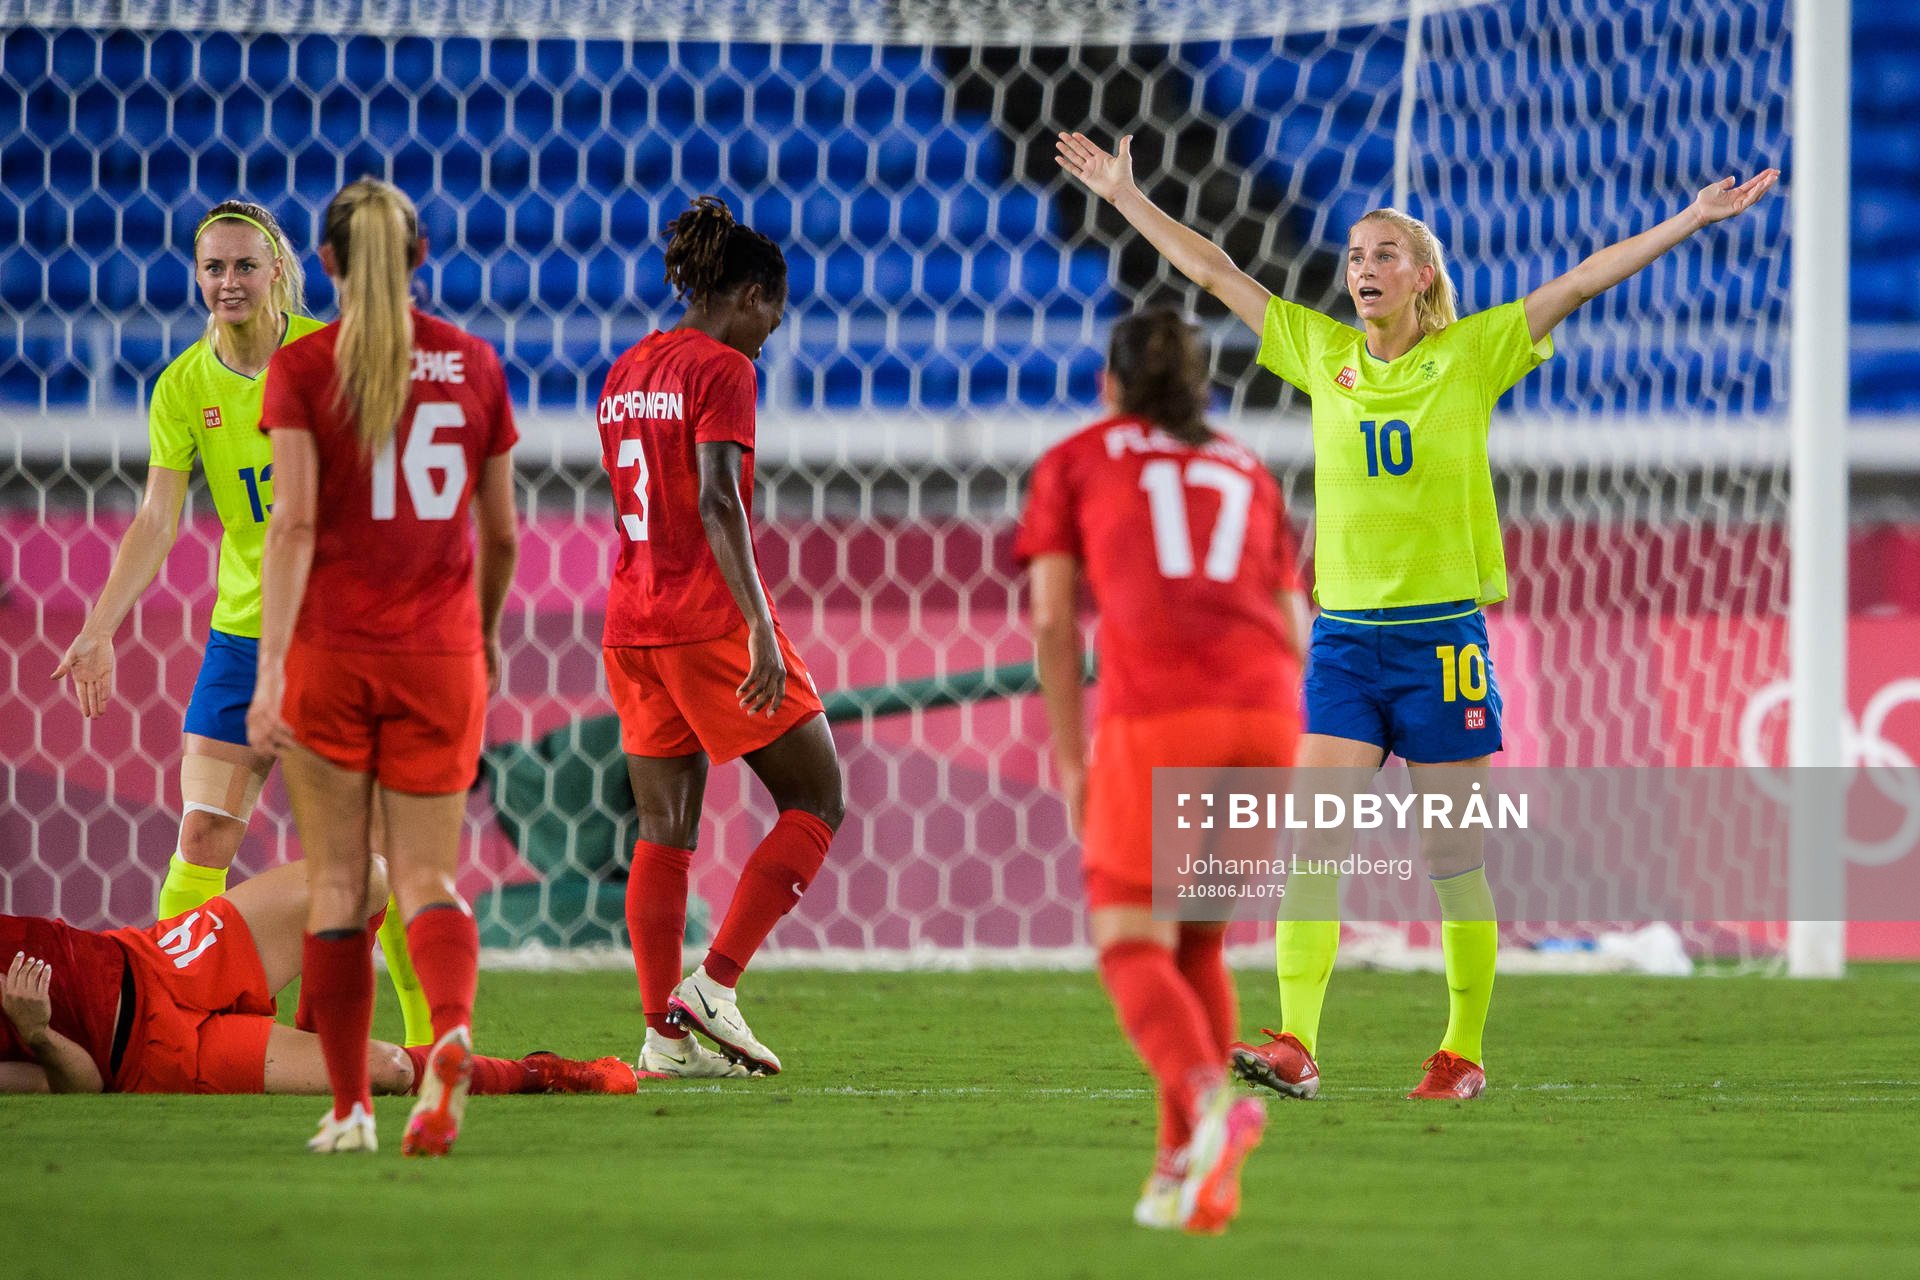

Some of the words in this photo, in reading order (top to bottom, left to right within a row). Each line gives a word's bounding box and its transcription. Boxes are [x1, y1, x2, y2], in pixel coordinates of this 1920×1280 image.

[1337, 376, 1353, 387] QLO
[204, 409, 218, 418] UNI
[206, 417, 220, 427] QLO
[371, 402, 468, 520] 16
[1360, 419, 1413, 477] 10
[617, 439, 649, 541] 3
[1139, 458, 1255, 583] 17
[1436, 643, 1487, 702] 10
[1467, 710, 1482, 718] UNI
[1468, 719, 1484, 728] QLO
[157, 911, 217, 969] 14
